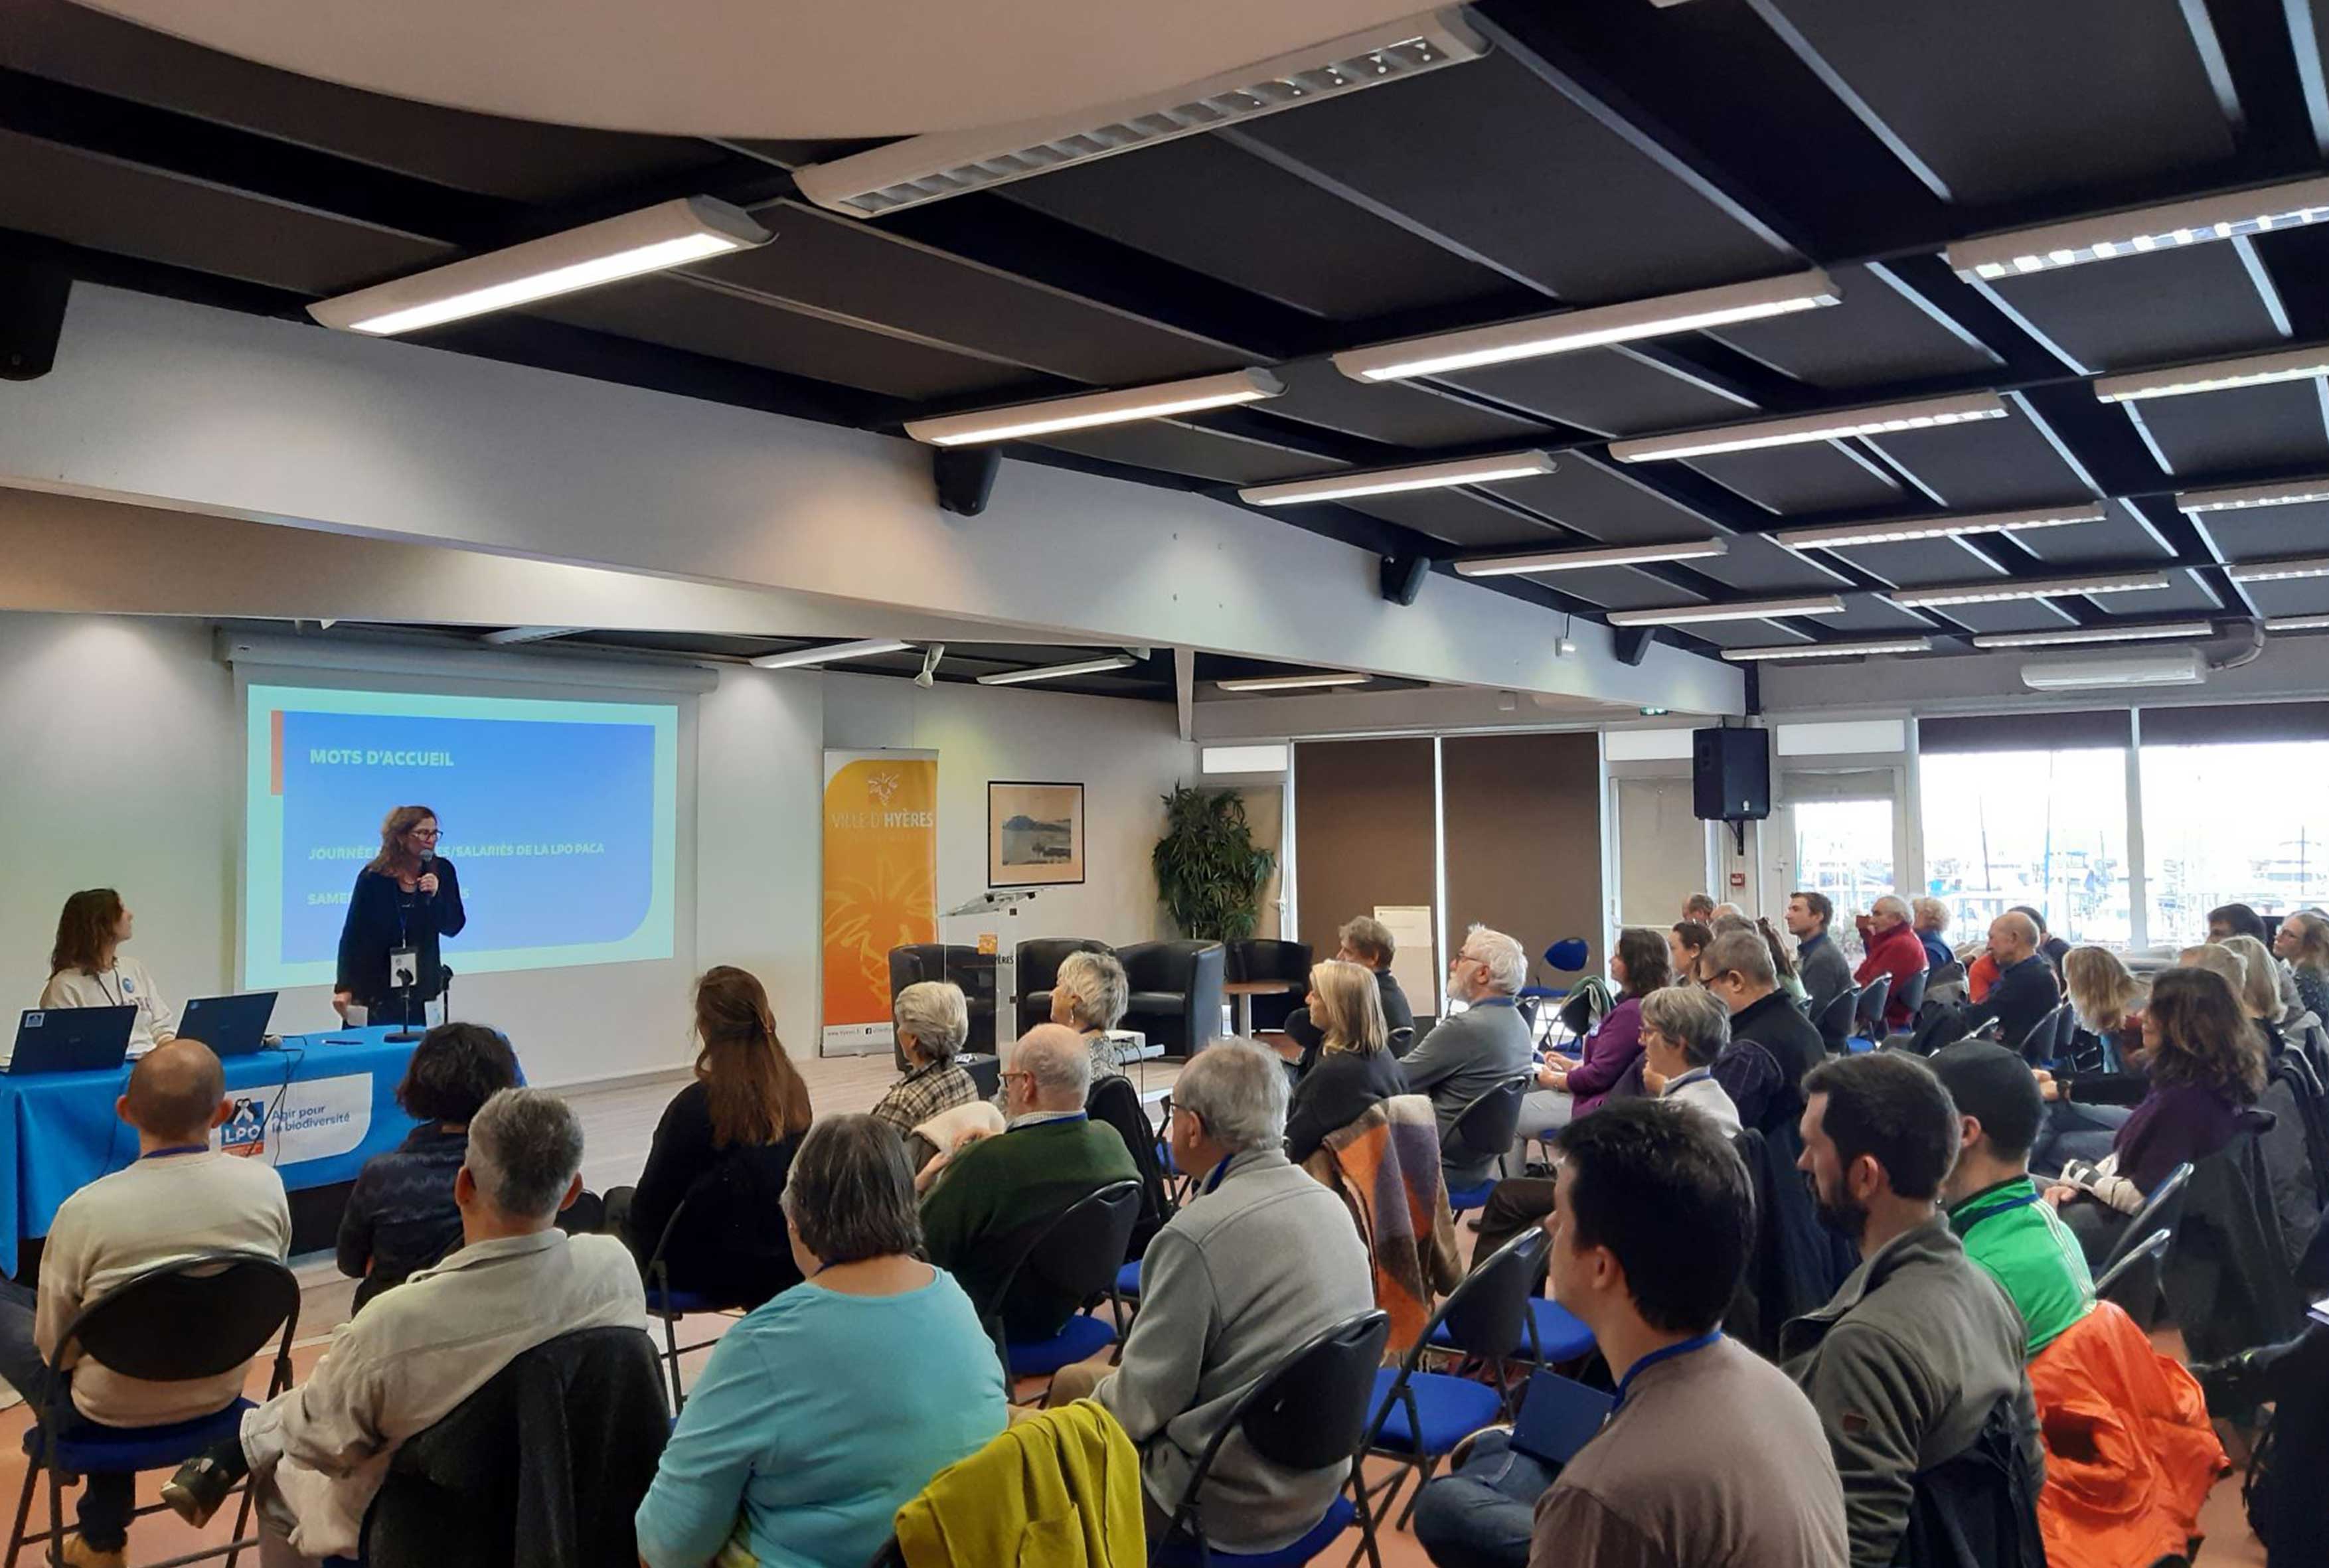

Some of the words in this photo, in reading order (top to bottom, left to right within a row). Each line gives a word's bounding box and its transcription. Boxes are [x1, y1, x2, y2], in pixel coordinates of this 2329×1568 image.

[309, 749, 362, 765] MOTS
[366, 751, 454, 767] D'ACCUEIL
[832, 812, 866, 828] VILLE
[516, 844, 532, 856] DE
[534, 844, 548, 855] LA
[551, 844, 573, 854] LPO
[575, 842, 605, 854] PACA
[308, 892, 349, 905] SAME
[272, 1109, 295, 1121] Agir
[299, 1105, 325, 1120] pour
[285, 1112, 351, 1132] biodiversité
[224, 1125, 262, 1143] LPO
